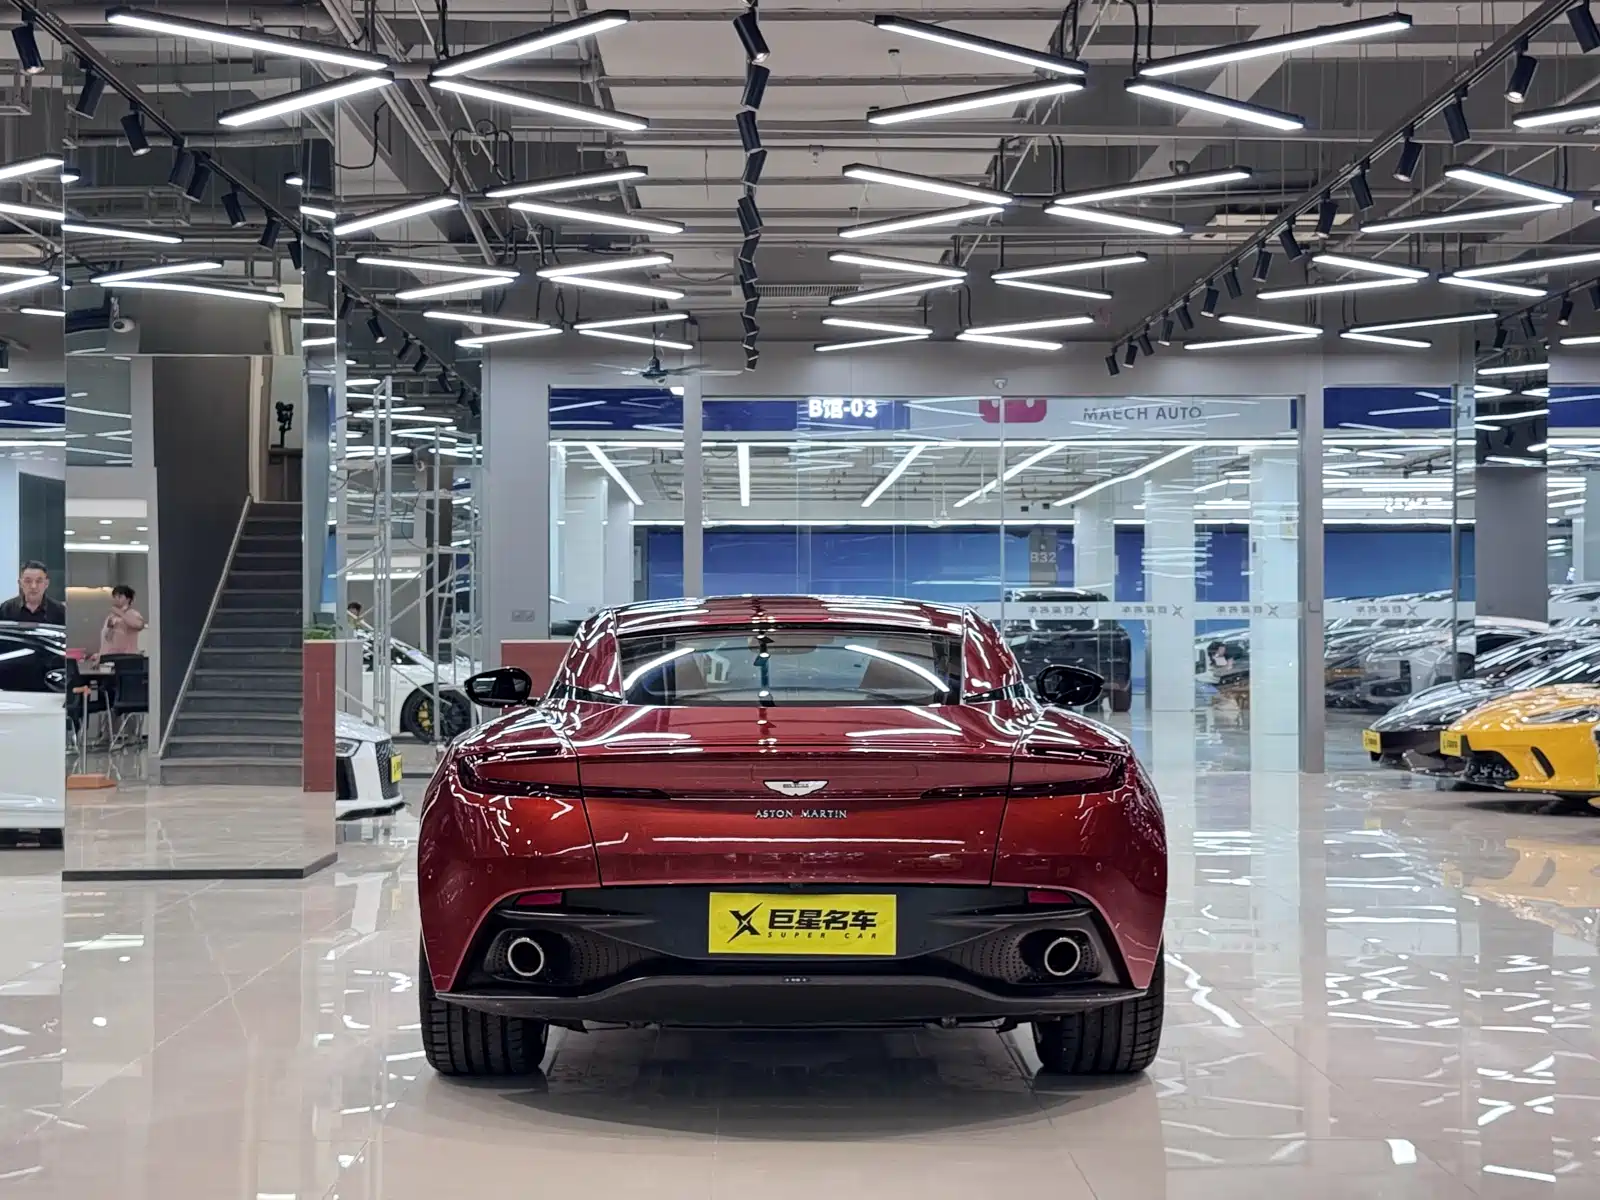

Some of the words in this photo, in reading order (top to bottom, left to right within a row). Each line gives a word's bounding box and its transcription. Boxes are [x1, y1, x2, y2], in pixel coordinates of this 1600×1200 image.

[1083, 406, 1148, 421] MAECH
[1156, 406, 1202, 420] AUTO
[1031, 551, 1057, 564] B32
[755, 809, 794, 818] ASTON
[800, 809, 847, 818] MARTIN
[768, 908, 878, 931] 巨星名车
